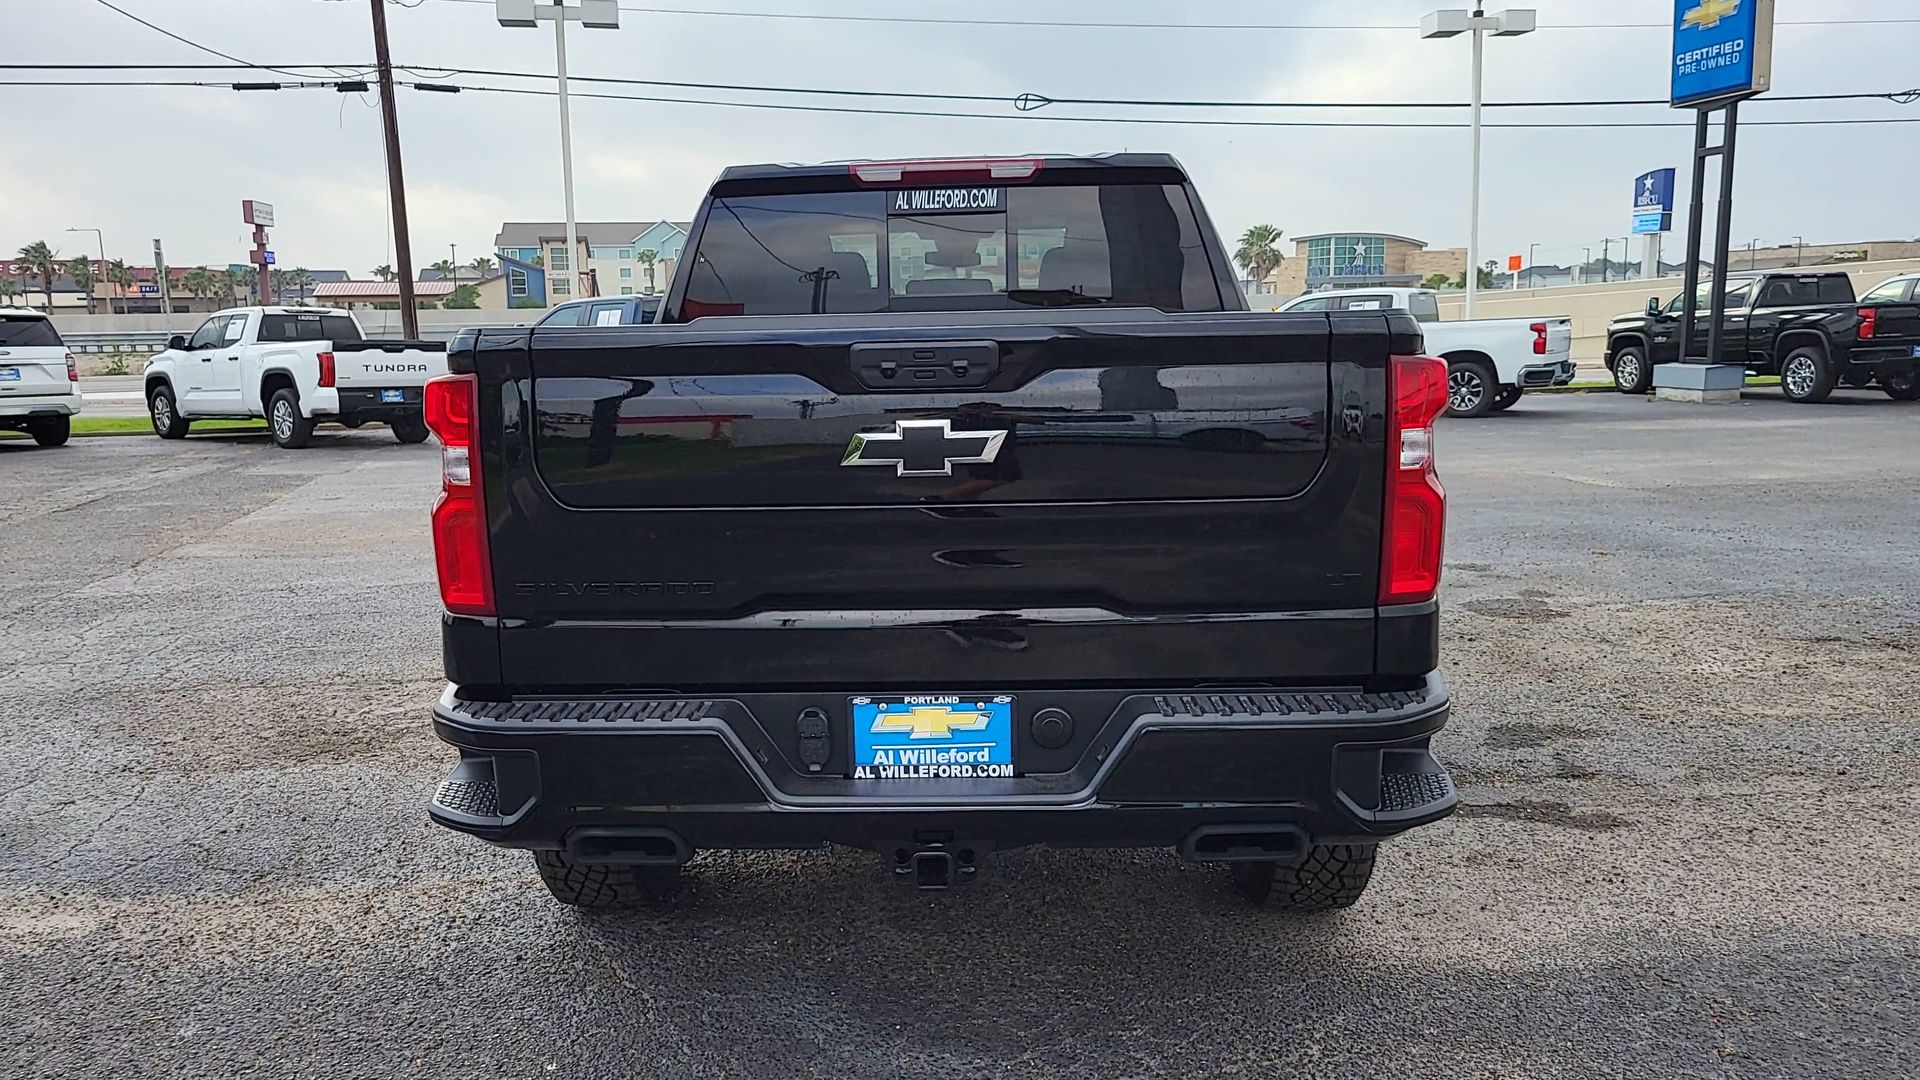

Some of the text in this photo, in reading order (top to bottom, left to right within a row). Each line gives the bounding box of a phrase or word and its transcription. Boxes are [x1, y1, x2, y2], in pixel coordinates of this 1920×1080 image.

[1676, 39, 1744, 66] CERTIFIED
[1678, 53, 1740, 76] PRE-OWNED
[895, 188, 998, 210] AL WILLEFORD.COM
[362, 364, 427, 372] TUNDRA
[515, 582, 715, 596] SILVERADO
[904, 696, 960, 705] PORTLAND
[873, 748, 990, 765] Al Willeford
[853, 764, 1014, 779] AL WILLEFORD.COM
